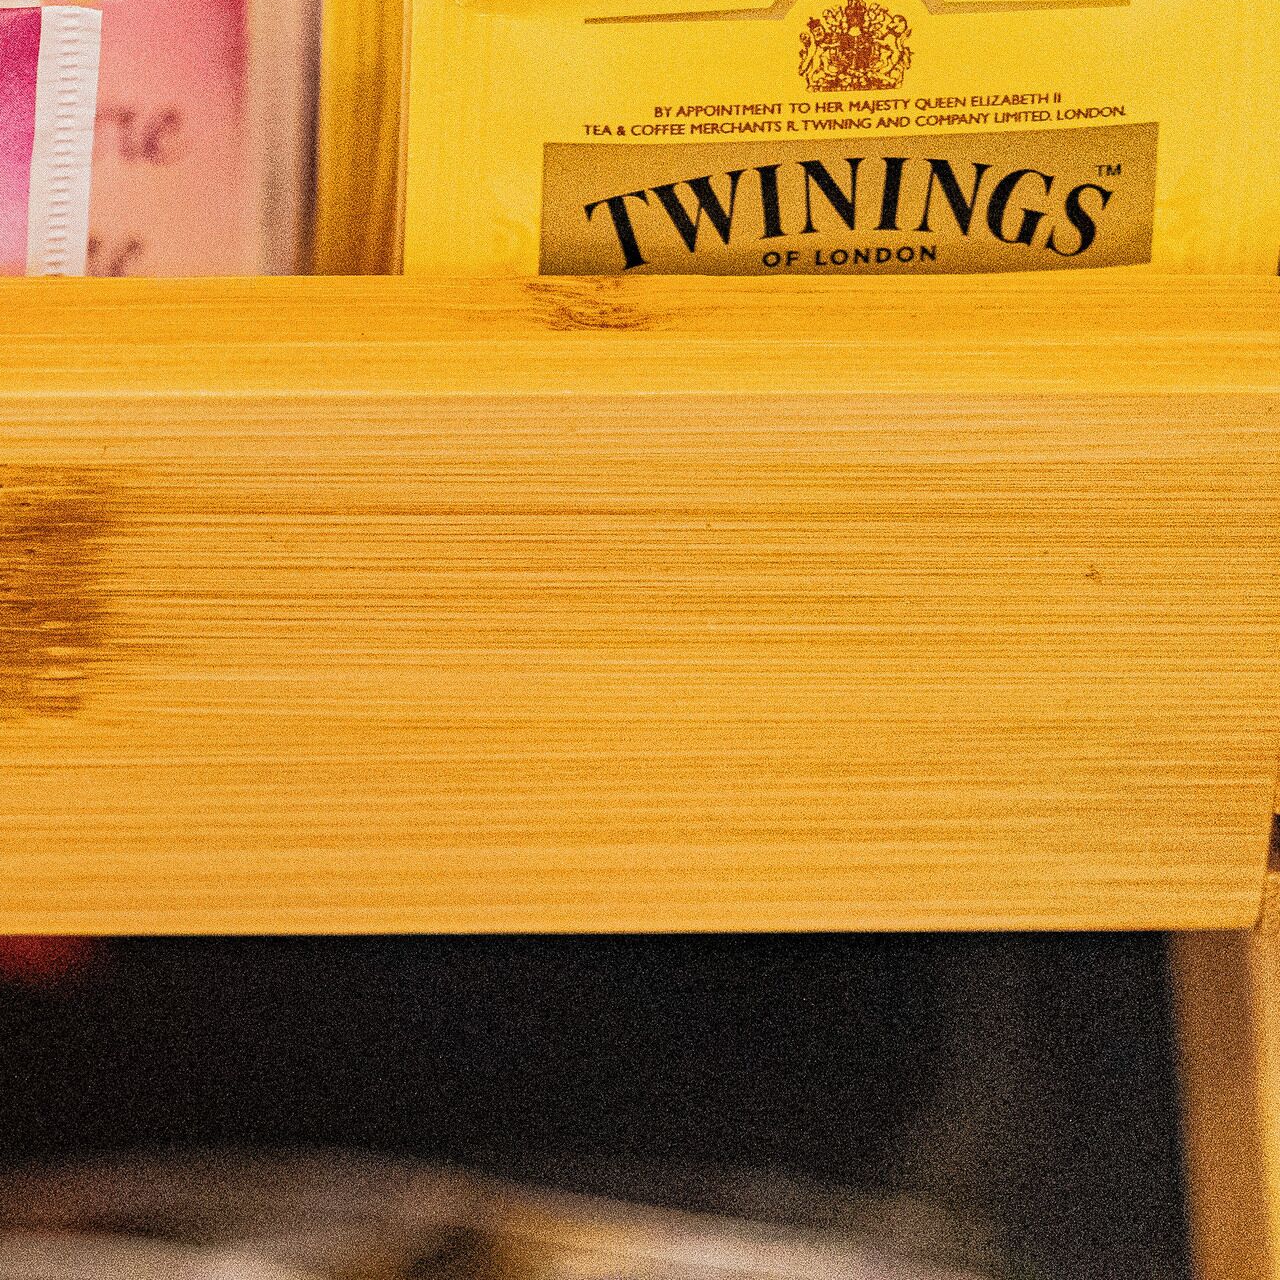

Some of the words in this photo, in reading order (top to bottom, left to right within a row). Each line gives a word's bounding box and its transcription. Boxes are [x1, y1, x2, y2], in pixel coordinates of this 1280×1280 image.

[654, 106, 672, 118] BY
[676, 103, 783, 118] APPOINTMENT
[790, 102, 810, 114] TO
[815, 101, 844, 113] HER
[849, 98, 910, 114] MAJESTY
[915, 96, 966, 111] QUEEN
[971, 93, 1049, 108] ELIZABETH
[1053, 92, 1062, 104] II
[584, 124, 612, 136] TEA
[617, 125, 626, 136] &
[631, 123, 685, 136] COFFEE
[690, 120, 782, 135] MERCHANTS
[801, 116, 872, 131] TWINING
[876, 116, 910, 129] AND
[915, 112, 990, 127] COMPANY
[583, 156, 1113, 271] TWININGS
[762, 248, 802, 268] OF
[814, 244, 938, 266] LONDON
